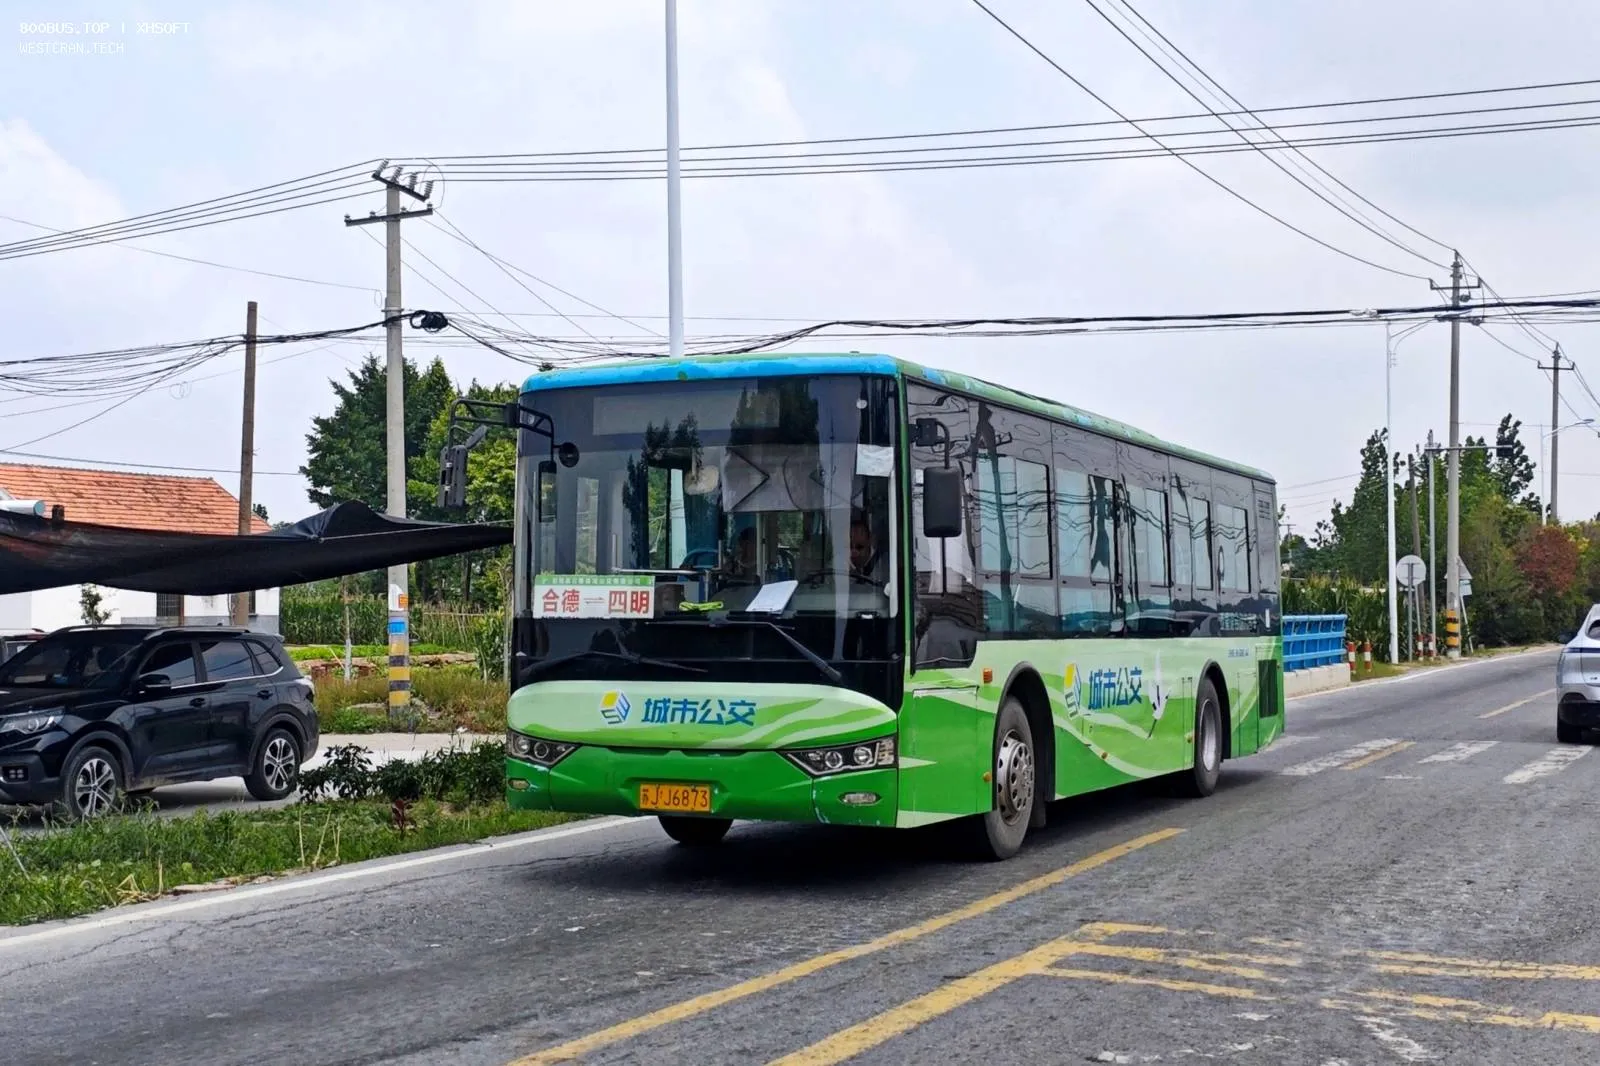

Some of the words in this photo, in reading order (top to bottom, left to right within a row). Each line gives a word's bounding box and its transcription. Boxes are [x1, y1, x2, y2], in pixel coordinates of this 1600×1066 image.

[541, 588, 580, 613] 合德
[608, 590, 650, 614] 四明
[1087, 666, 1143, 710] 城市公交
[641, 698, 757, 726] 城市公交
